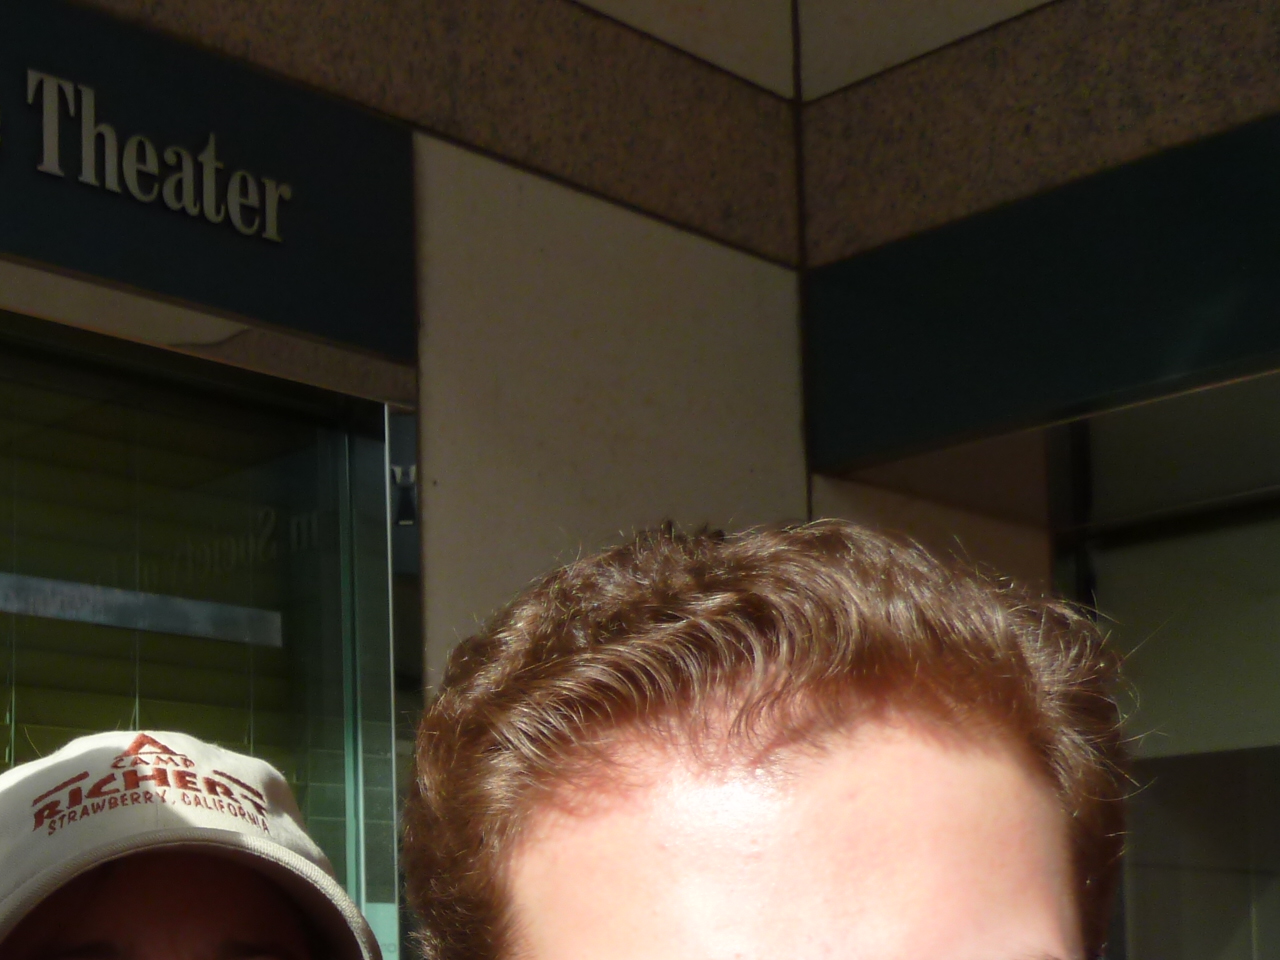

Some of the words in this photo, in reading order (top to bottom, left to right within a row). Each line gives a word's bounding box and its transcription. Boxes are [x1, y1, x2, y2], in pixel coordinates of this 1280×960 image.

[27, 68, 292, 242] Theater
[110, 755, 196, 769] CAMP
[32, 767, 268, 832] RICHERT
[180, 792, 271, 834] CALIFORNIA
